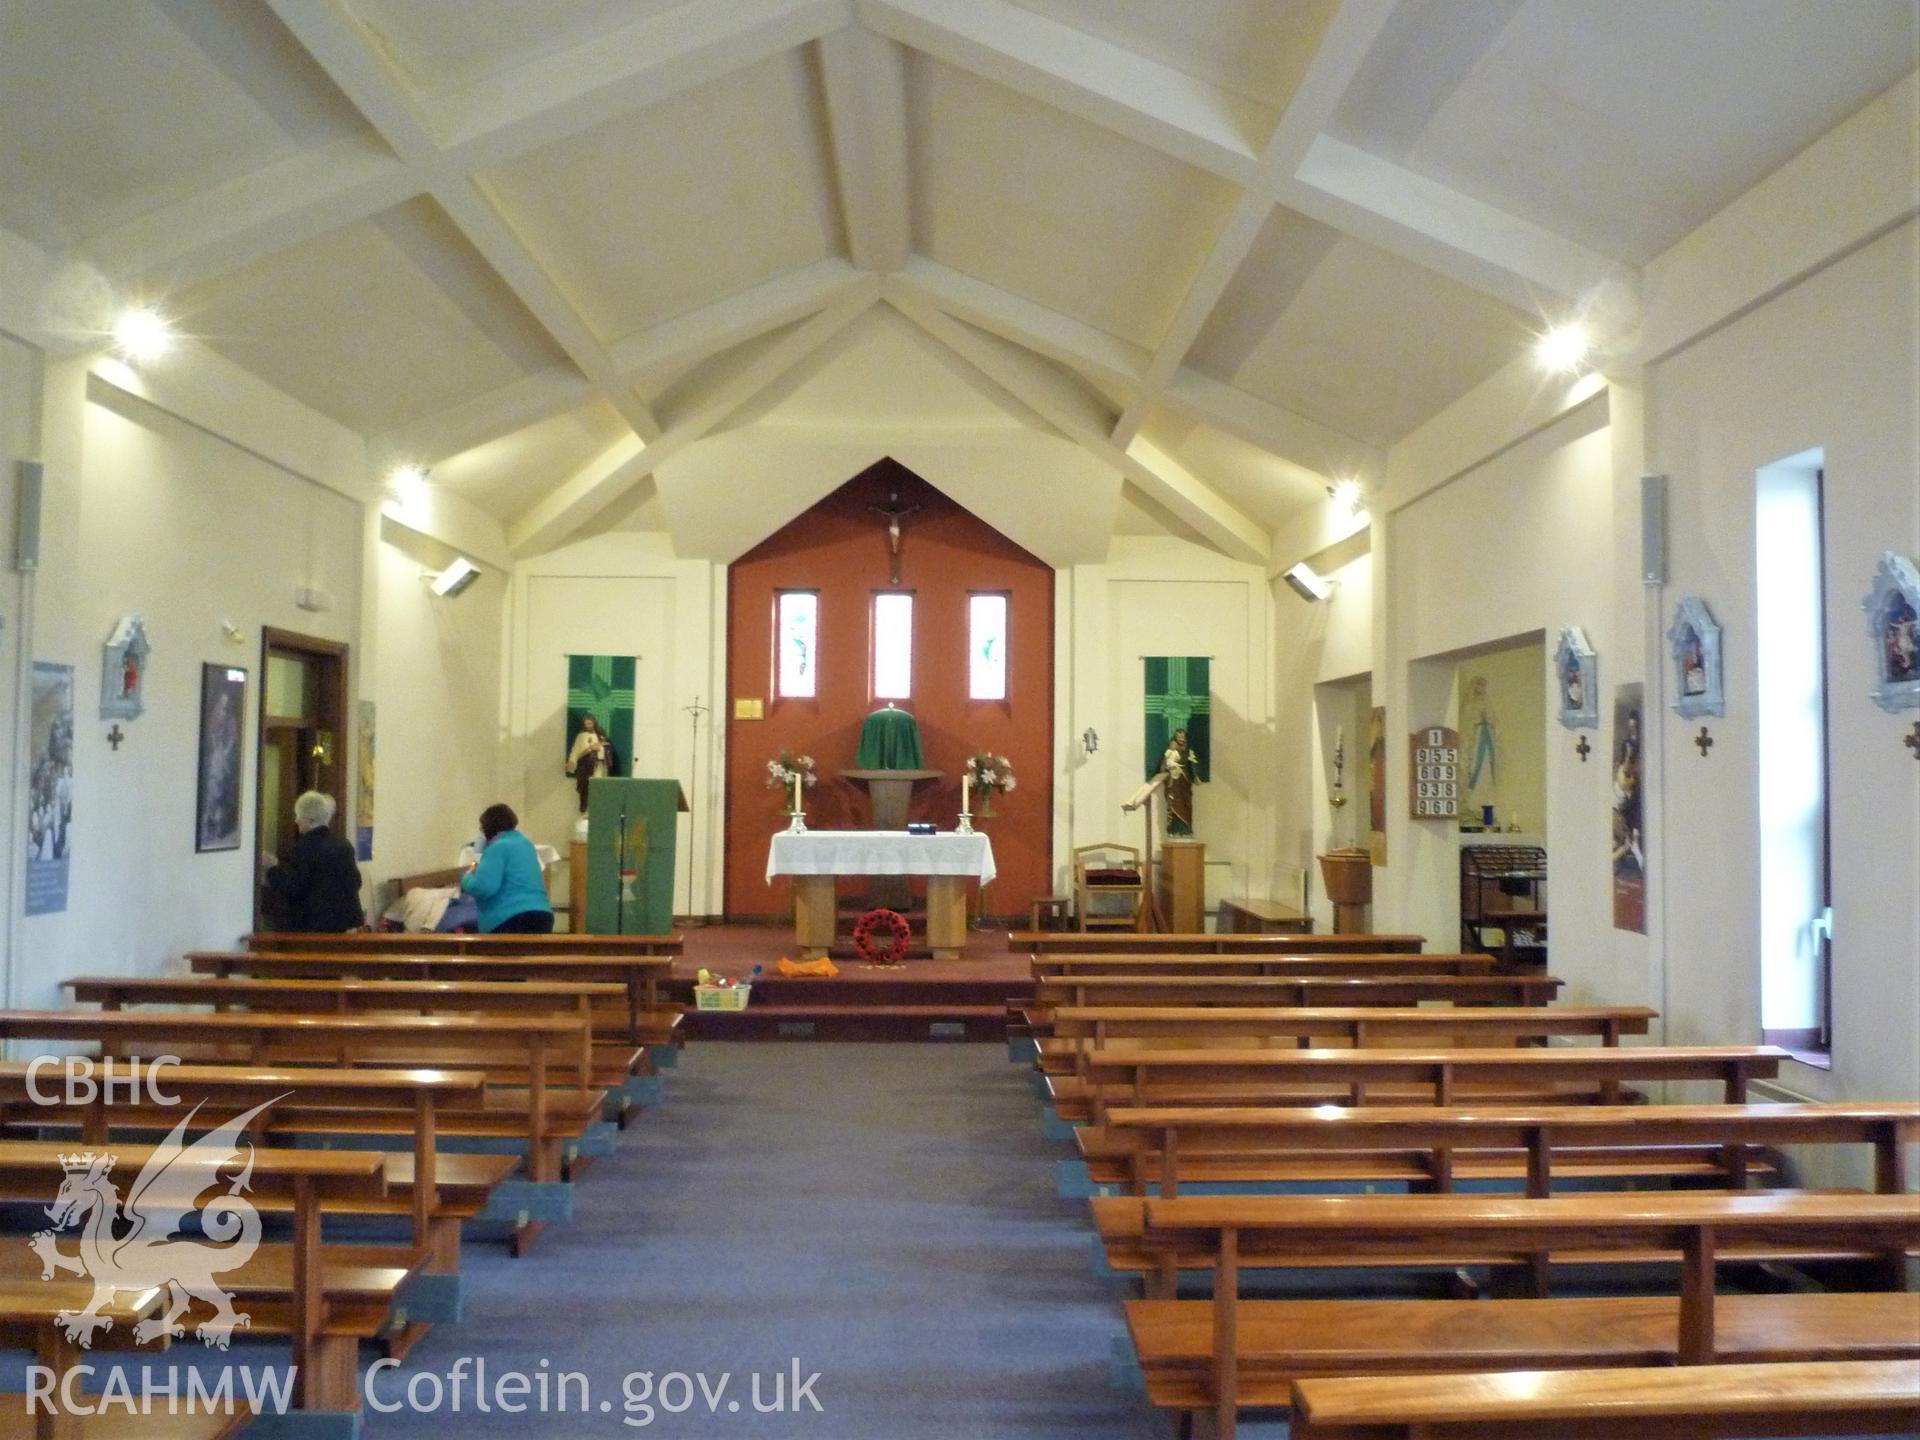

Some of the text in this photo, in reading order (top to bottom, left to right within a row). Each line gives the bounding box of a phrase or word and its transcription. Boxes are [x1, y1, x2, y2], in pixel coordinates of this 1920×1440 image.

[1432, 732, 1439, 743] 1
[1419, 749, 1454, 762] 955
[1421, 766, 1453, 779] 609
[1420, 783, 1453, 796] 938
[1419, 801, 1453, 814] 960
